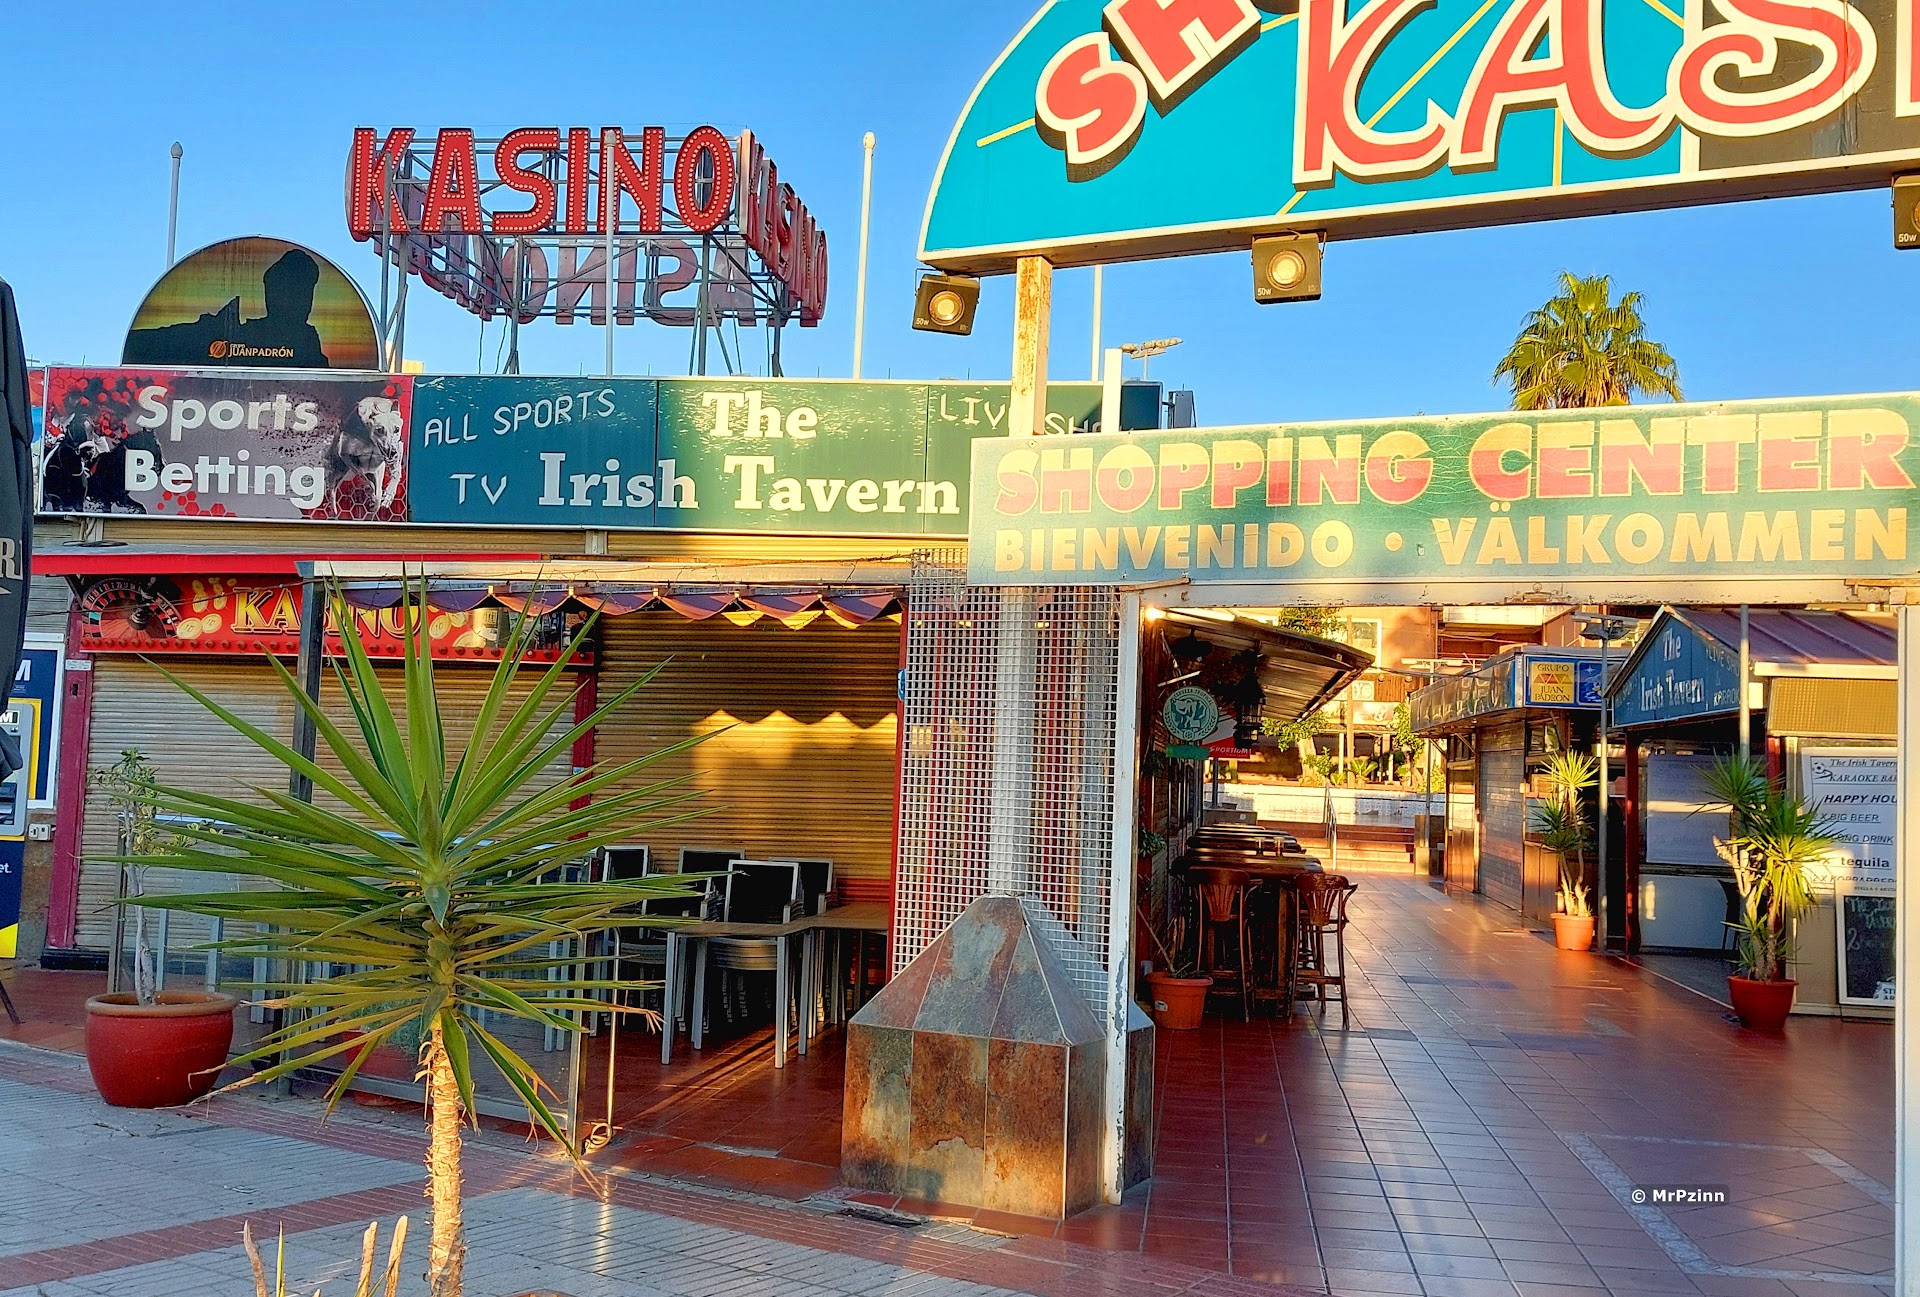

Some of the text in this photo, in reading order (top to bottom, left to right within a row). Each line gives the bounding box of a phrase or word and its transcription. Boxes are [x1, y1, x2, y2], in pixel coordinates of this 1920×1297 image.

[352, 126, 735, 235] KASINO
[228, 346, 294, 358] JUANPADRÓN
[136, 385, 318, 441] Sports
[424, 388, 616, 447] ALL SPORTS
[701, 389, 818, 439] The
[993, 407, 1917, 516] SHOPPING CENTER
[124, 449, 325, 508] Betting
[449, 474, 507, 505] TV
[538, 452, 960, 514] Irish Tavern
[994, 501, 1908, 572] BIENVENIDO VÄLKOMMEN
[1663, 628, 1681, 661] The
[1537, 663, 1569, 672] GRUPO
[1540, 686, 1564, 694] JUAN
[1640, 676, 1664, 711] Irish
[1666, 669, 1705, 706] Tavern
[1829, 774, 1879, 782] KARAOKE
[1830, 759, 1845, 767] The
[1848, 759, 1867, 767] Irish
[1824, 795, 1869, 803] HAPPY
[1830, 813, 1847, 821] BIG
[1850, 814, 1879, 822] BEER
[1862, 834, 1894, 843] DRINK
[1841, 857, 1890, 868] tequila
